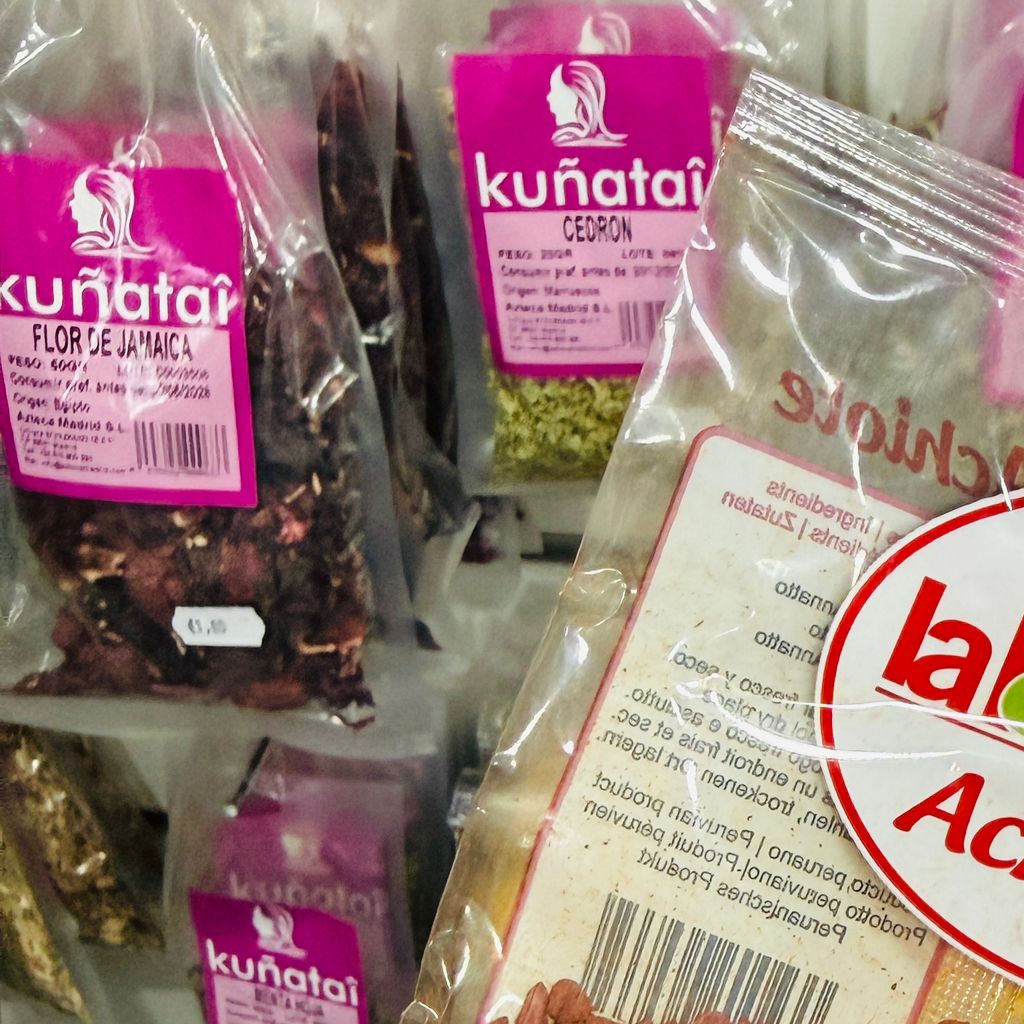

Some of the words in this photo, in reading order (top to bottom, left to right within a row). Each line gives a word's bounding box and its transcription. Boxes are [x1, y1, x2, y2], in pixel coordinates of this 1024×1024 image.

[475, 152, 706, 208] kuñataî
[562, 215, 633, 243] CEDRON
[32, 323, 83, 354] FLOR
[89, 328, 112, 357] DE
[117, 330, 193, 361] JAMAICA
